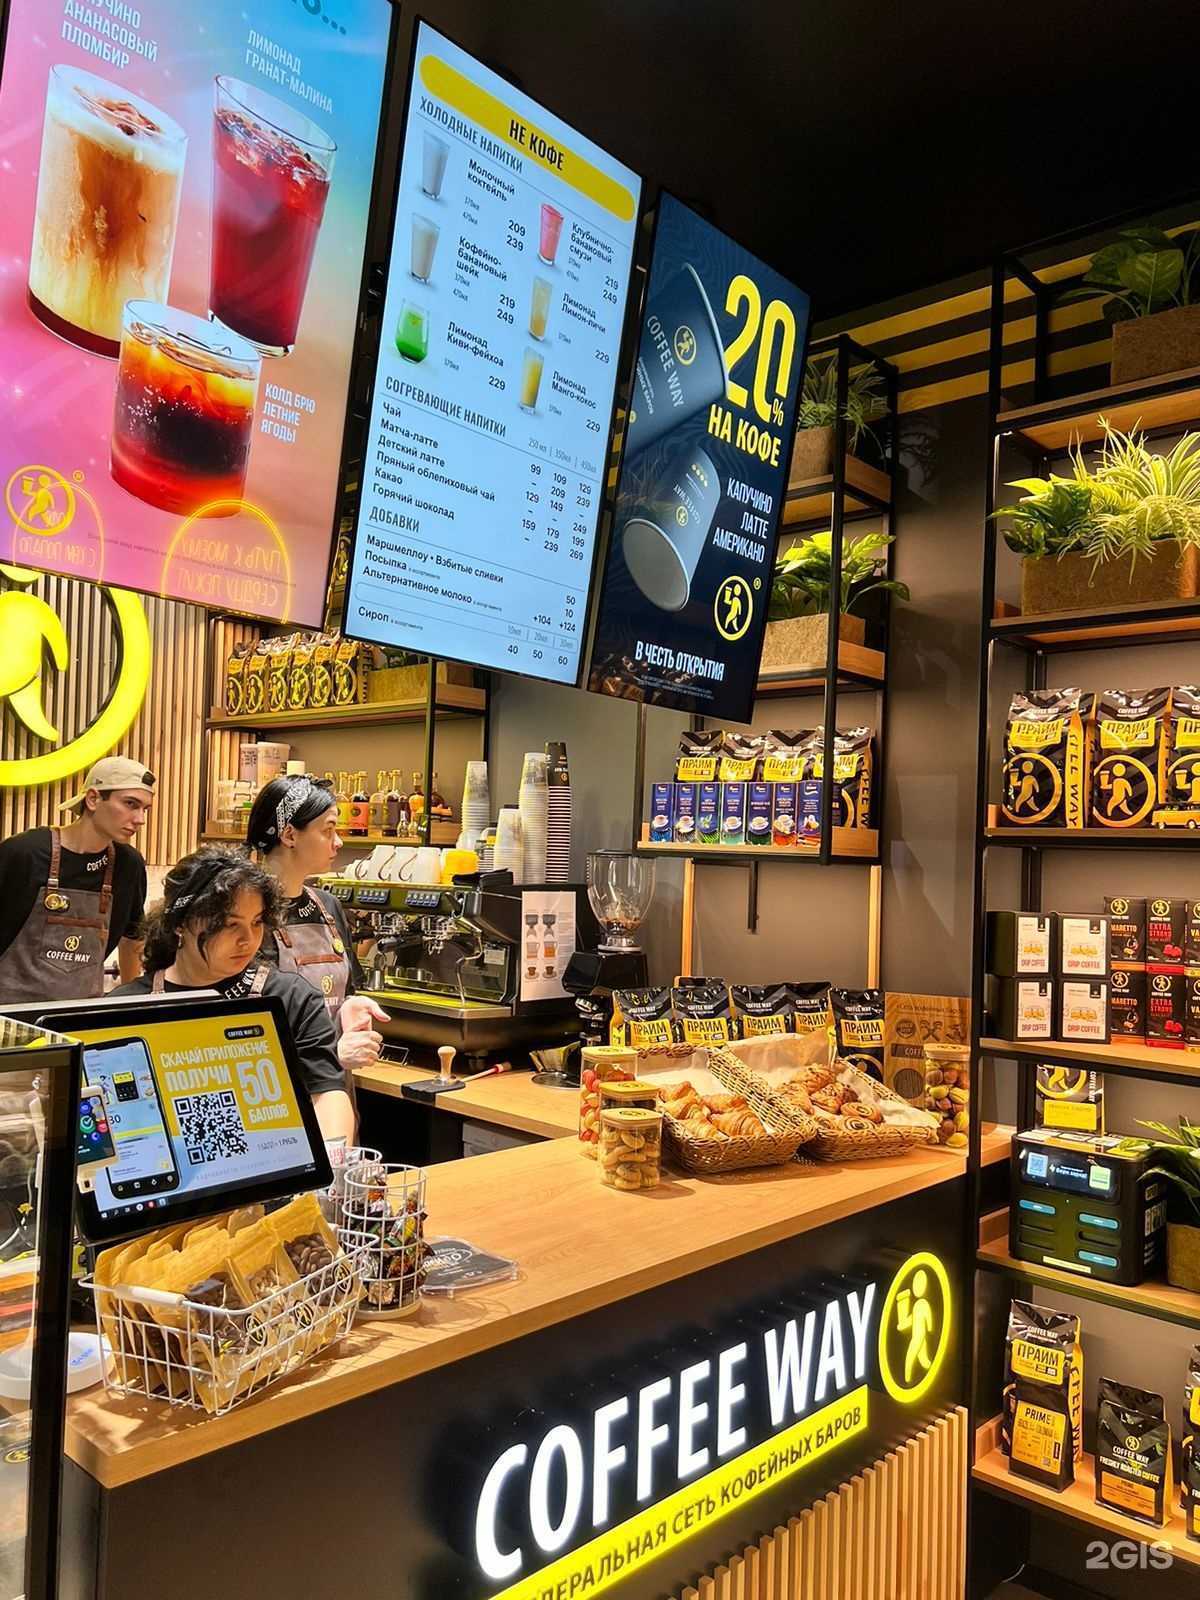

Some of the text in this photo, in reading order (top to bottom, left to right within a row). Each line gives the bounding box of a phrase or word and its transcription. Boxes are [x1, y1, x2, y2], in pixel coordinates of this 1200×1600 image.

[62, 21, 130, 69] ПЛОМБИР
[64, 0, 158, 62] АНАНАСОВЫЙ
[248, 30, 301, 75] ЛИМОНАД
[245, 48, 333, 114] ГРАНАТ-МАЛИНА
[419, 96, 523, 174] ХОЛОДНЫЕ НАПИТКИ
[509, 119, 564, 171] НЕ КОФЕ
[467, 172, 507, 201] коктейль
[468, 158, 515, 195] Молочный
[506, 234, 524, 252] 239
[507, 219, 526, 236] 209
[572, 222, 614, 254] Клубнично-
[457, 247, 508, 282] банановый
[459, 236, 501, 265] Кофейно-
[569, 245, 592, 263] смузи
[571, 232, 612, 264] банановый
[456, 260, 480, 278] шейк
[605, 275, 619, 290] 219
[499, 294, 515, 309] 219
[563, 293, 596, 319] Лимонад
[603, 289, 618, 304] 249
[496, 308, 514, 324] 249
[447, 332, 504, 367] Киви-фейхоа
[448, 321, 488, 349] Лимонад
[595, 349, 609, 364] 229
[647, 315, 684, 407] COFFEE WAY
[265, 383, 316, 414] КОЛД БРЮ
[488, 375, 505, 391] 229
[552, 381, 597, 410] Манго-кокос
[553, 371, 587, 395] Лимонад
[263, 401, 300, 427] ЛЕТНИЕ
[385, 376, 507, 438] СОГРЕВАЮЩИЕ НАПИТКИ
[260, 420, 296, 443] ЯГОДЫ
[586, 419, 601, 433] 229
[708, 403, 782, 467] НА КОФЕ
[380, 418, 590, 508] Матча-латте 209 239
[383, 401, 591, 495] Чай 99 109 129
[378, 434, 563, 512] Детский латте 129 149
[375, 467, 585, 547] Какао 159 179 199
[376, 450, 587, 534] Пряный облепиховый чай 249
[727, 477, 773, 515] КАПУЧИНО
[369, 506, 420, 533] ДОБАВКИ
[373, 483, 583, 561] Горячий шоколад 239 269
[740, 511, 769, 539] ЛАТТЕ
[712, 527, 766, 564] АМЕРИКАНО
[364, 550, 574, 618] Посыпка 10
[366, 534, 429, 563] Маршмеллоу
[435, 555, 473, 575] Взбитые
[474, 569, 504, 584] сливки
[566, 595, 576, 605] 50
[363, 566, 439, 594] Альтернативное
[441, 589, 472, 604] молоко
[533, 614, 551, 625] +104
[559, 622, 576, 632] +124
[358, 606, 568, 665] Сироп 40 50 60
[635, 640, 725, 681] В ЧЕСТЬ ОТКРЫТИЯ
[1070, 784, 1078, 827] WAY
[46, 950, 91, 963] COFFEE WAY
[160, 1040, 271, 1068] СКАЧАЙ ПРИЛОЖЕНИЕ
[165, 1058, 282, 1105] ПОЛУЧИ 50
[248, 1104, 289, 1123] БАЛЛОВ
[475, 1283, 876, 1581] COFFEE WAY
[1113, 1445, 1150, 1464] COFFEE WAY
[530, 1405, 862, 1600] ДЕРАЛЬНАЯ СЕТЬ КОФЕЙНЫХ БАРОВ
